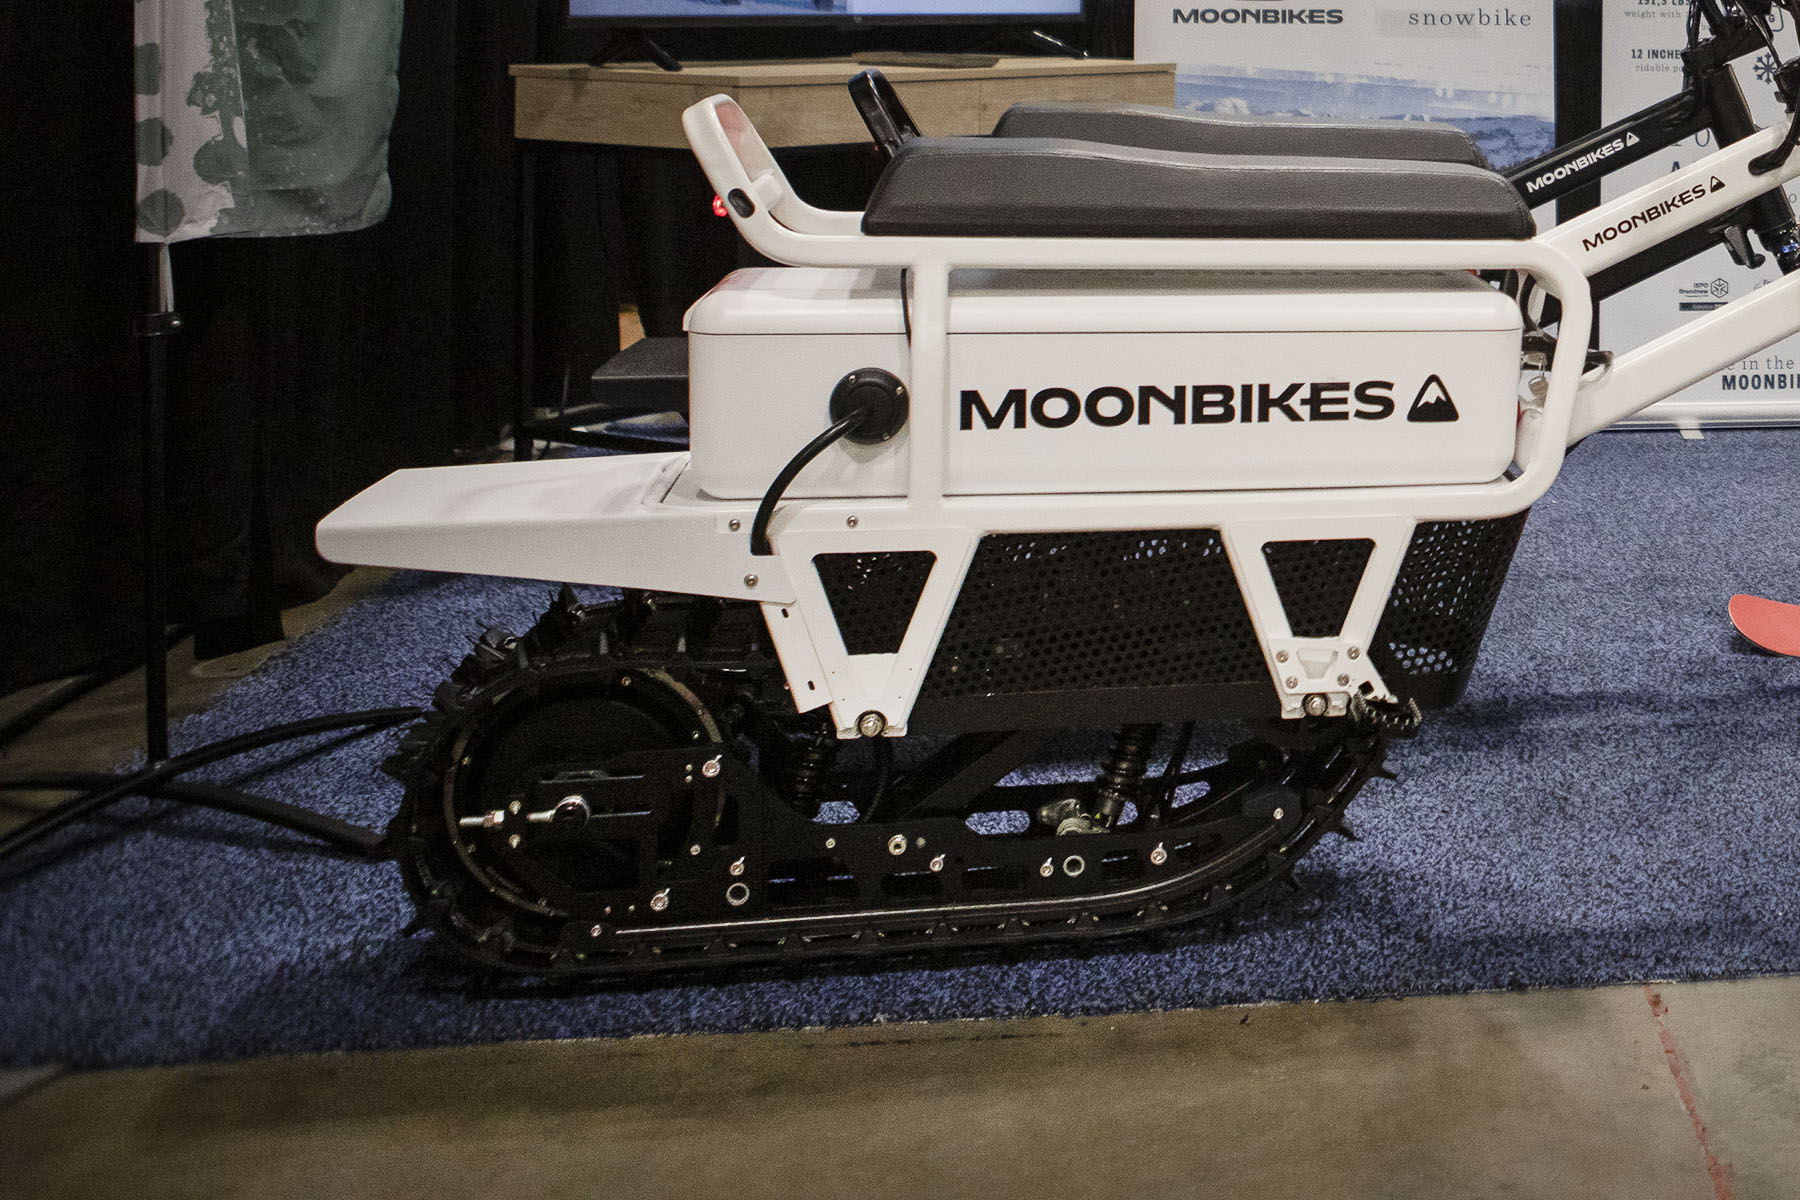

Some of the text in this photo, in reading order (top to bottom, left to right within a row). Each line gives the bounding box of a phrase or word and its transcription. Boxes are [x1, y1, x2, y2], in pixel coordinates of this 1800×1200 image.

[1172, 8, 1344, 24] MOONBIKES
[1408, 8, 1532, 27] snowbike
[1624, 10, 1656, 20] weight
[1660, 10, 1681, 19] with
[1631, 49, 1682, 60] 12 INCHE
[1636, 64, 1670, 73] ridable
[1525, 137, 1625, 194] MOONBIKES
[1581, 183, 1706, 252] MOONBIKES
[1742, 358, 1759, 370] in
[1766, 356, 1794, 370] the
[958, 379, 1397, 431] MOONBIKES
